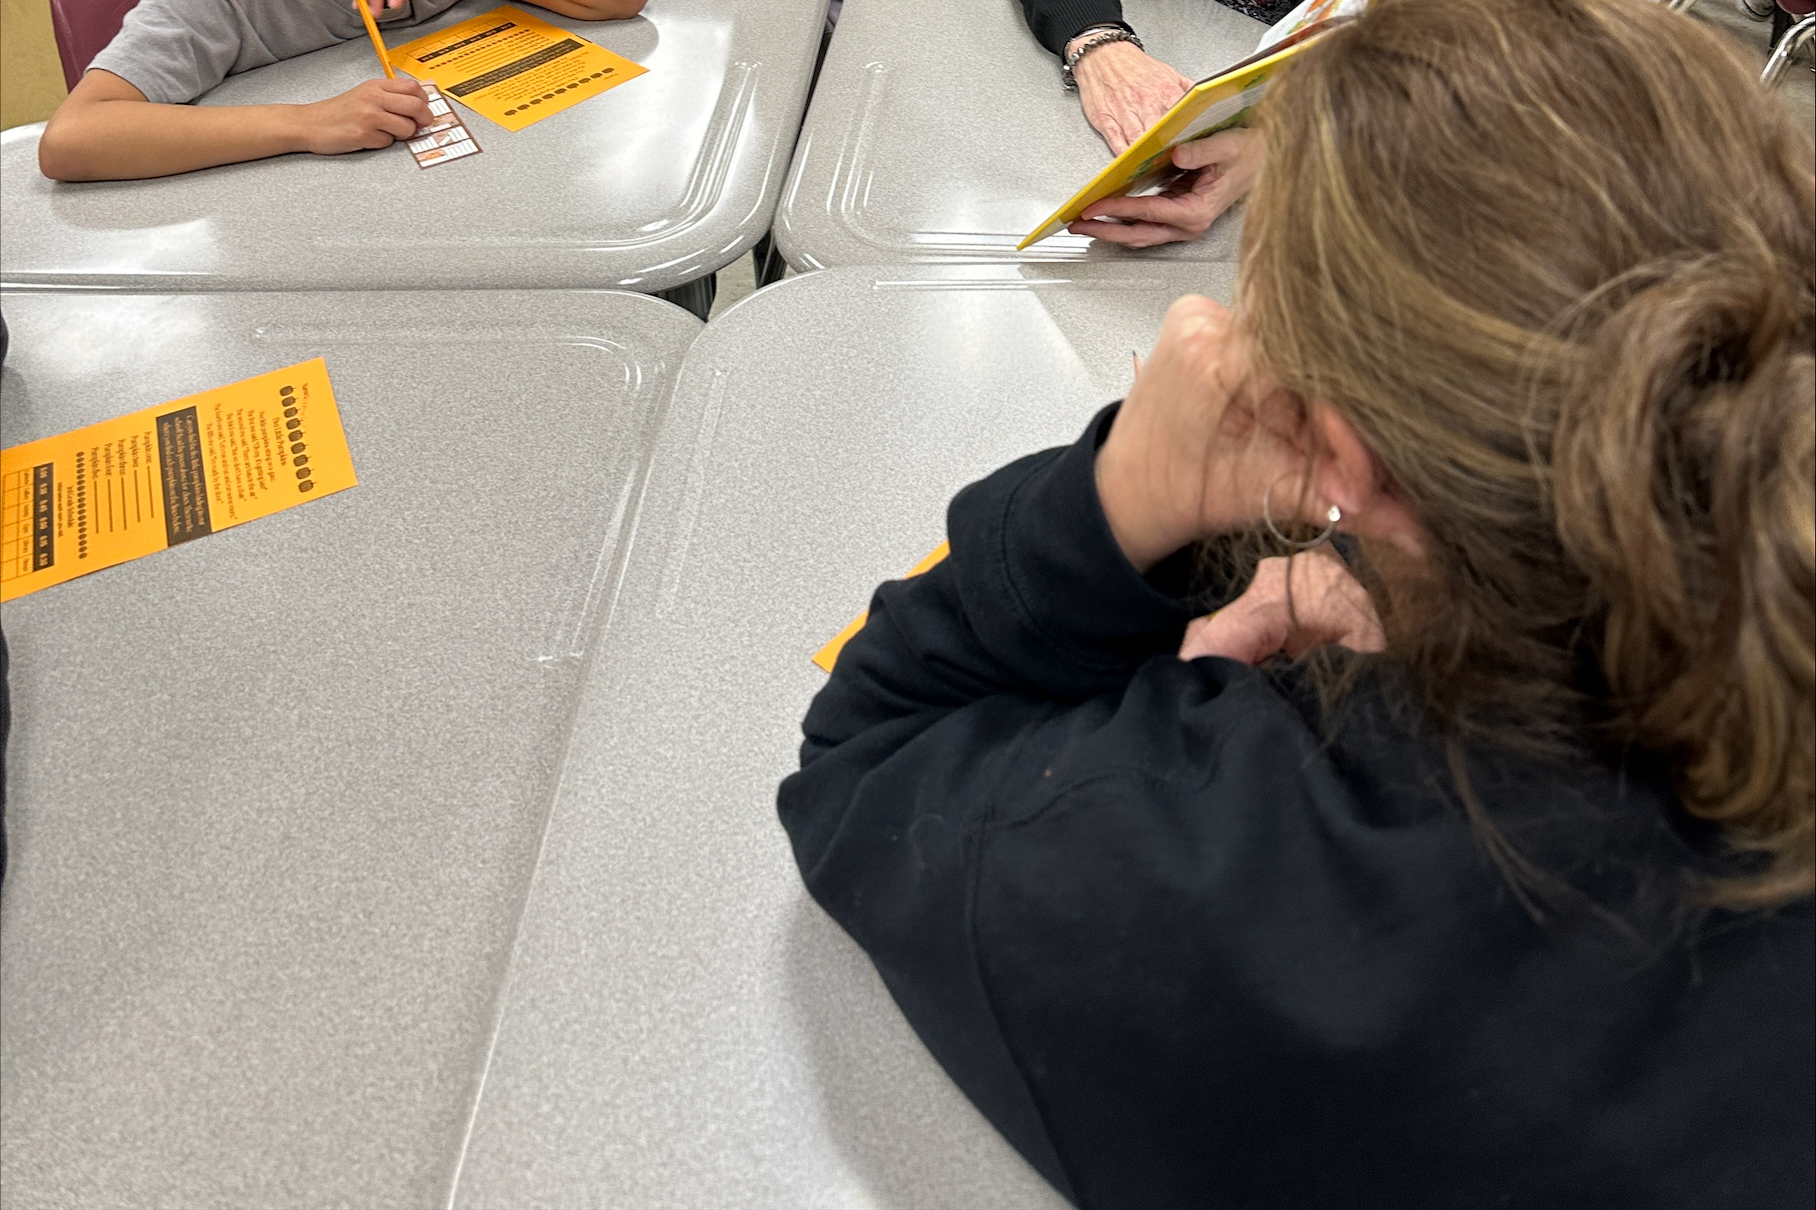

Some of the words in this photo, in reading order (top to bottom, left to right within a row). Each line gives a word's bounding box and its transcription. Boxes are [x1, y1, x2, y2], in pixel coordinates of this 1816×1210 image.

[117, 439, 126, 460] Pumpkin
[130, 436, 139, 457] Pumpkin
[143, 432, 152, 453] Pumpkin
[278, 441, 286, 465] Pumpkins
[90, 447, 99, 469] Pumpkin
[104, 443, 112, 465] Pumpkin
